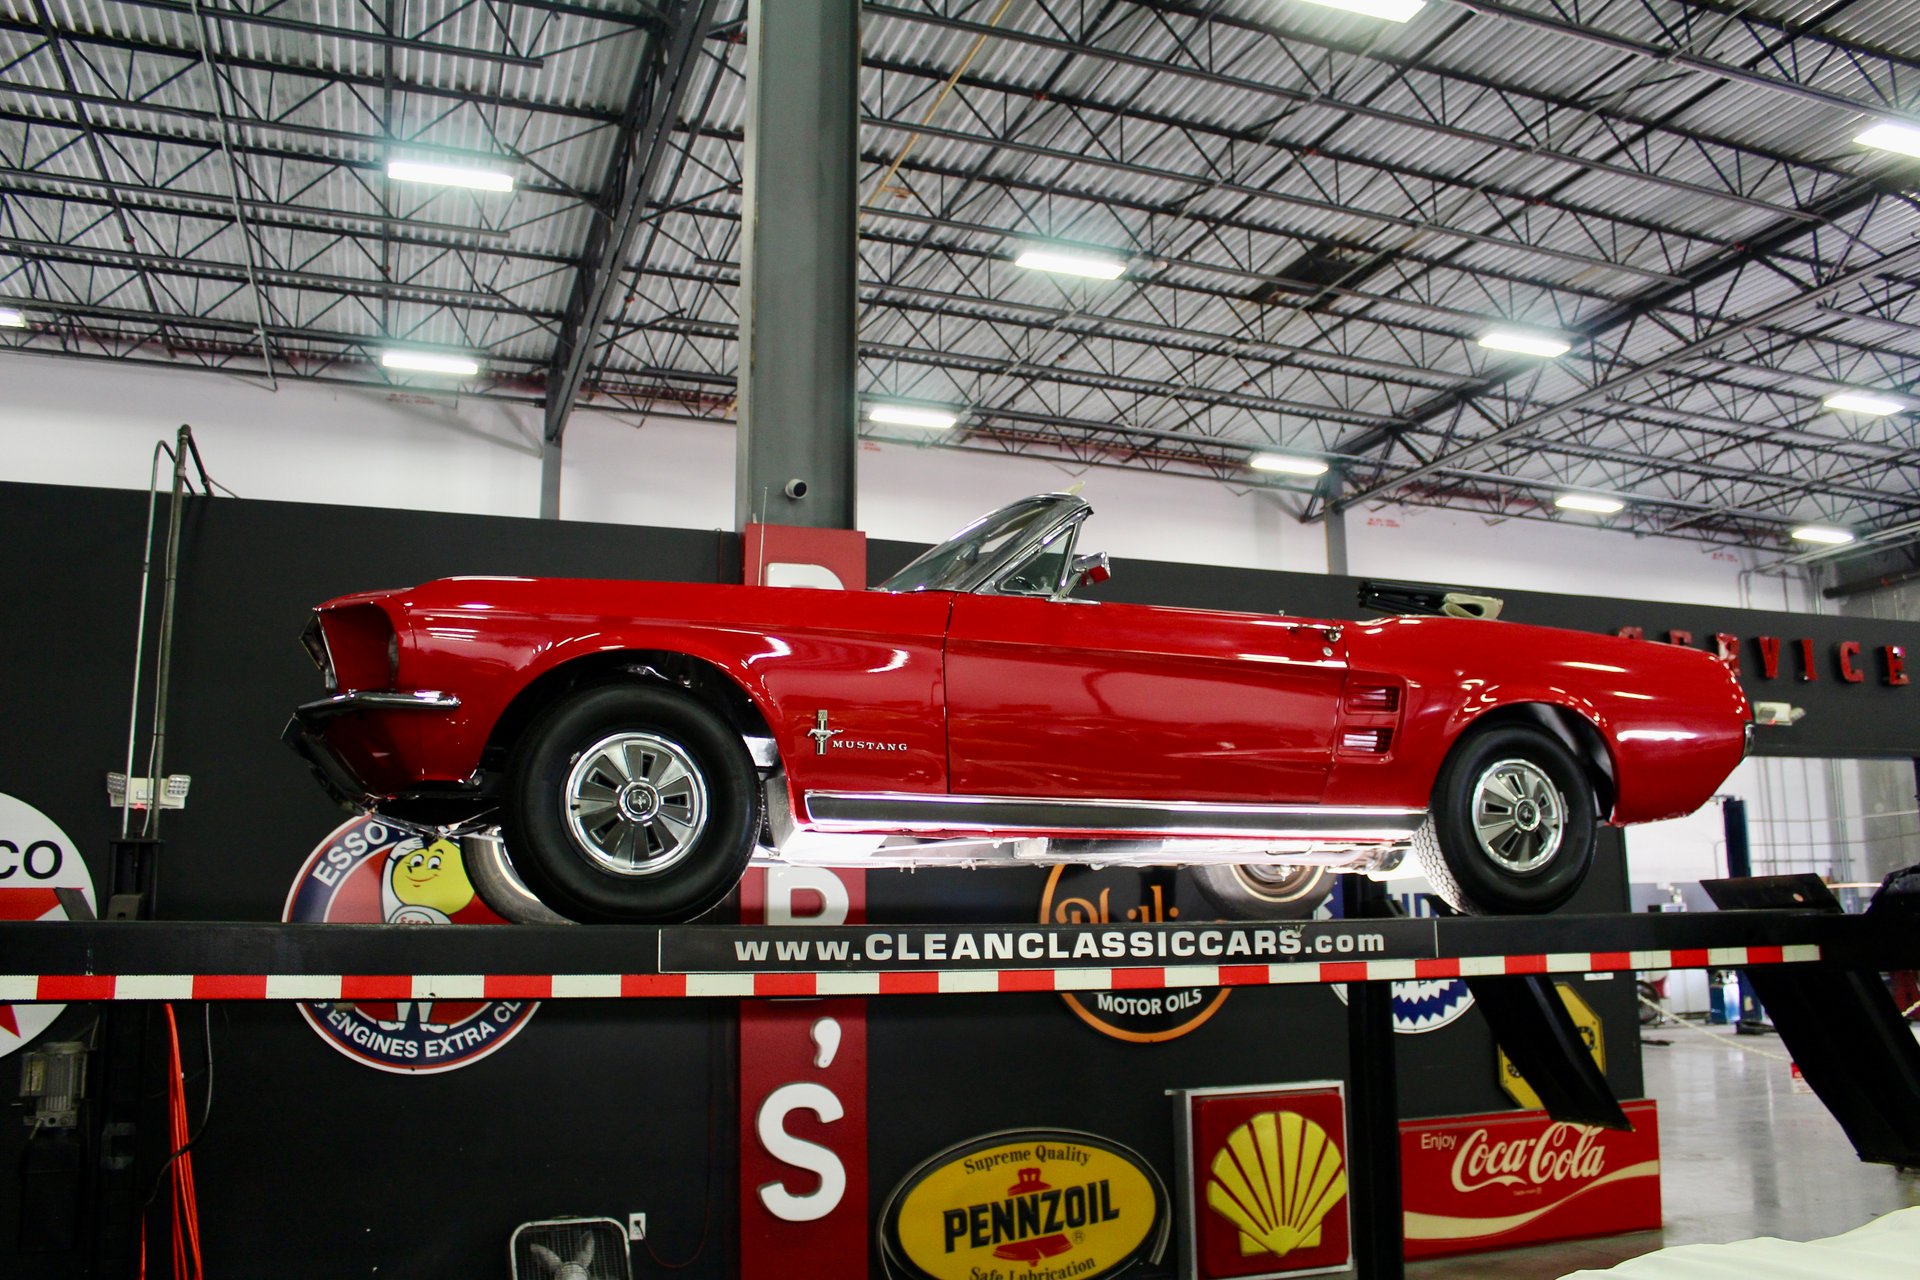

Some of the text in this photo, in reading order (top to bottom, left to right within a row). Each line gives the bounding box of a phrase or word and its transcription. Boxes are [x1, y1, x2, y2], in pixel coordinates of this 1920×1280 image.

[1617, 626, 1910, 685] RVICE
[832, 740, 908, 751] MUSTANG
[312, 821, 389, 887] ESSO
[734, 930, 1385, 961] www.CLEANCLASSICCARS.com
[1097, 988, 1203, 1016] MOTOR OILS
[327, 1008, 419, 1058] ENGINES
[425, 1021, 496, 1058] EXTRA
[963, 1145, 1091, 1175] Supreme Quality
[1421, 1132, 1457, 1150] Enjoy
[1451, 1121, 1605, 1193] Coca-Cola
[942, 1179, 1120, 1254] PENNZOIL
